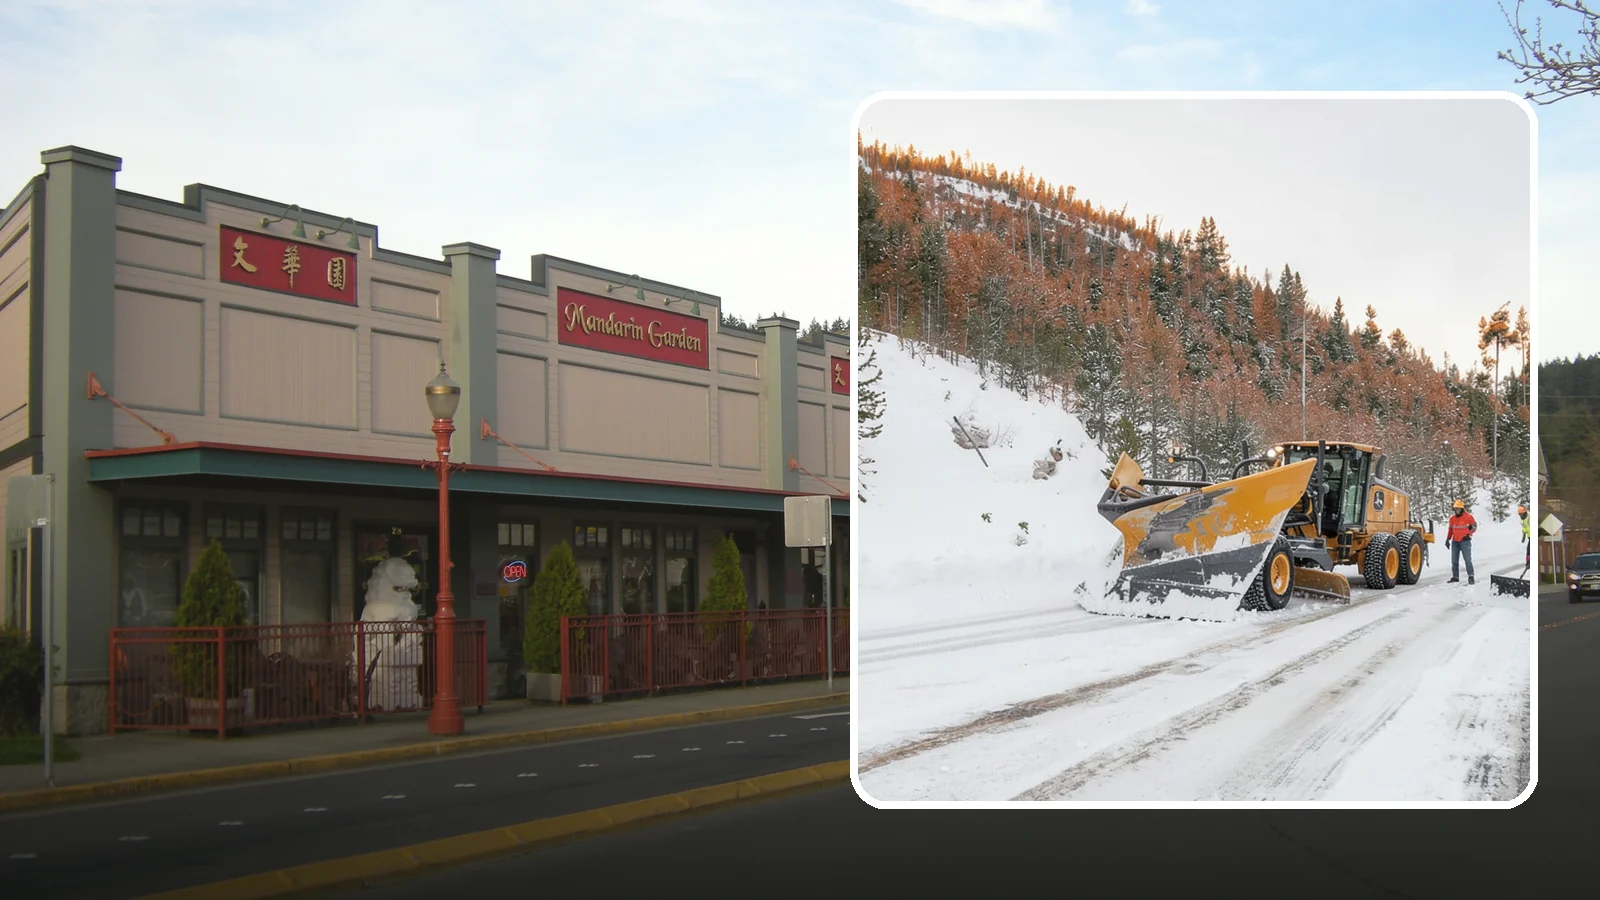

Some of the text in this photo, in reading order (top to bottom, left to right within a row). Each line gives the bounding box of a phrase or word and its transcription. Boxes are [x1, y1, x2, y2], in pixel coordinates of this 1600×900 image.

[231, 236, 346, 290] 文華園
[565, 302, 702, 352] Mandarin Garden
[503, 565, 527, 578] OPEN
